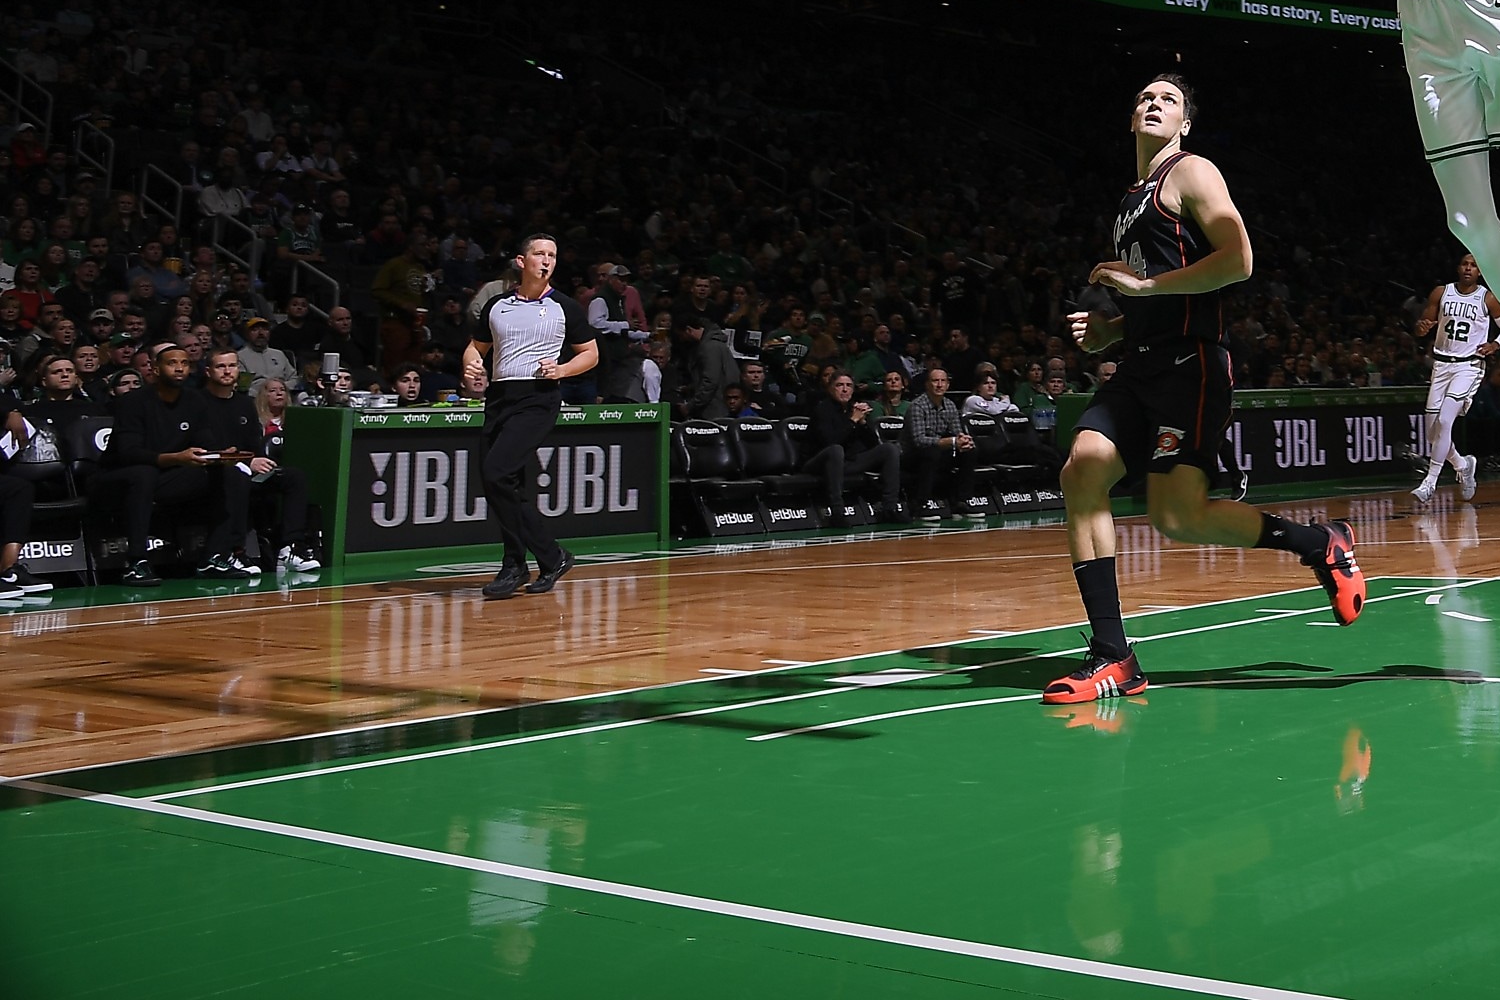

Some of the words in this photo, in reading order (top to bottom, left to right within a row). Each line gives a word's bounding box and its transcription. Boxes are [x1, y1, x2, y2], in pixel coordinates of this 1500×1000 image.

[1268, 5, 1280, 17] a
[1282, 5, 1323, 24] story.
[1331, 9, 1370, 29] Every
[1121, 241, 1147, 279] 4
[1443, 301, 1478, 321] CELTICS
[1444, 320, 1470, 342] 42
[360, 413, 389, 425] xfinity
[403, 412, 431, 424] xfinity
[445, 411, 472, 423] xfinity
[562, 410, 587, 421] xfinity
[599, 409, 623, 420] xfinity
[635, 408, 658, 419] xfinity
[1273, 418, 1326, 469] JBL
[1344, 415, 1392, 464] JBL
[370, 448, 488, 528] JBL
[536, 444, 639, 518] JBL
[714, 513, 754, 528] jetBlue
[769, 508, 807, 523] jetBlue
[17, 541, 74, 560] etBlue
